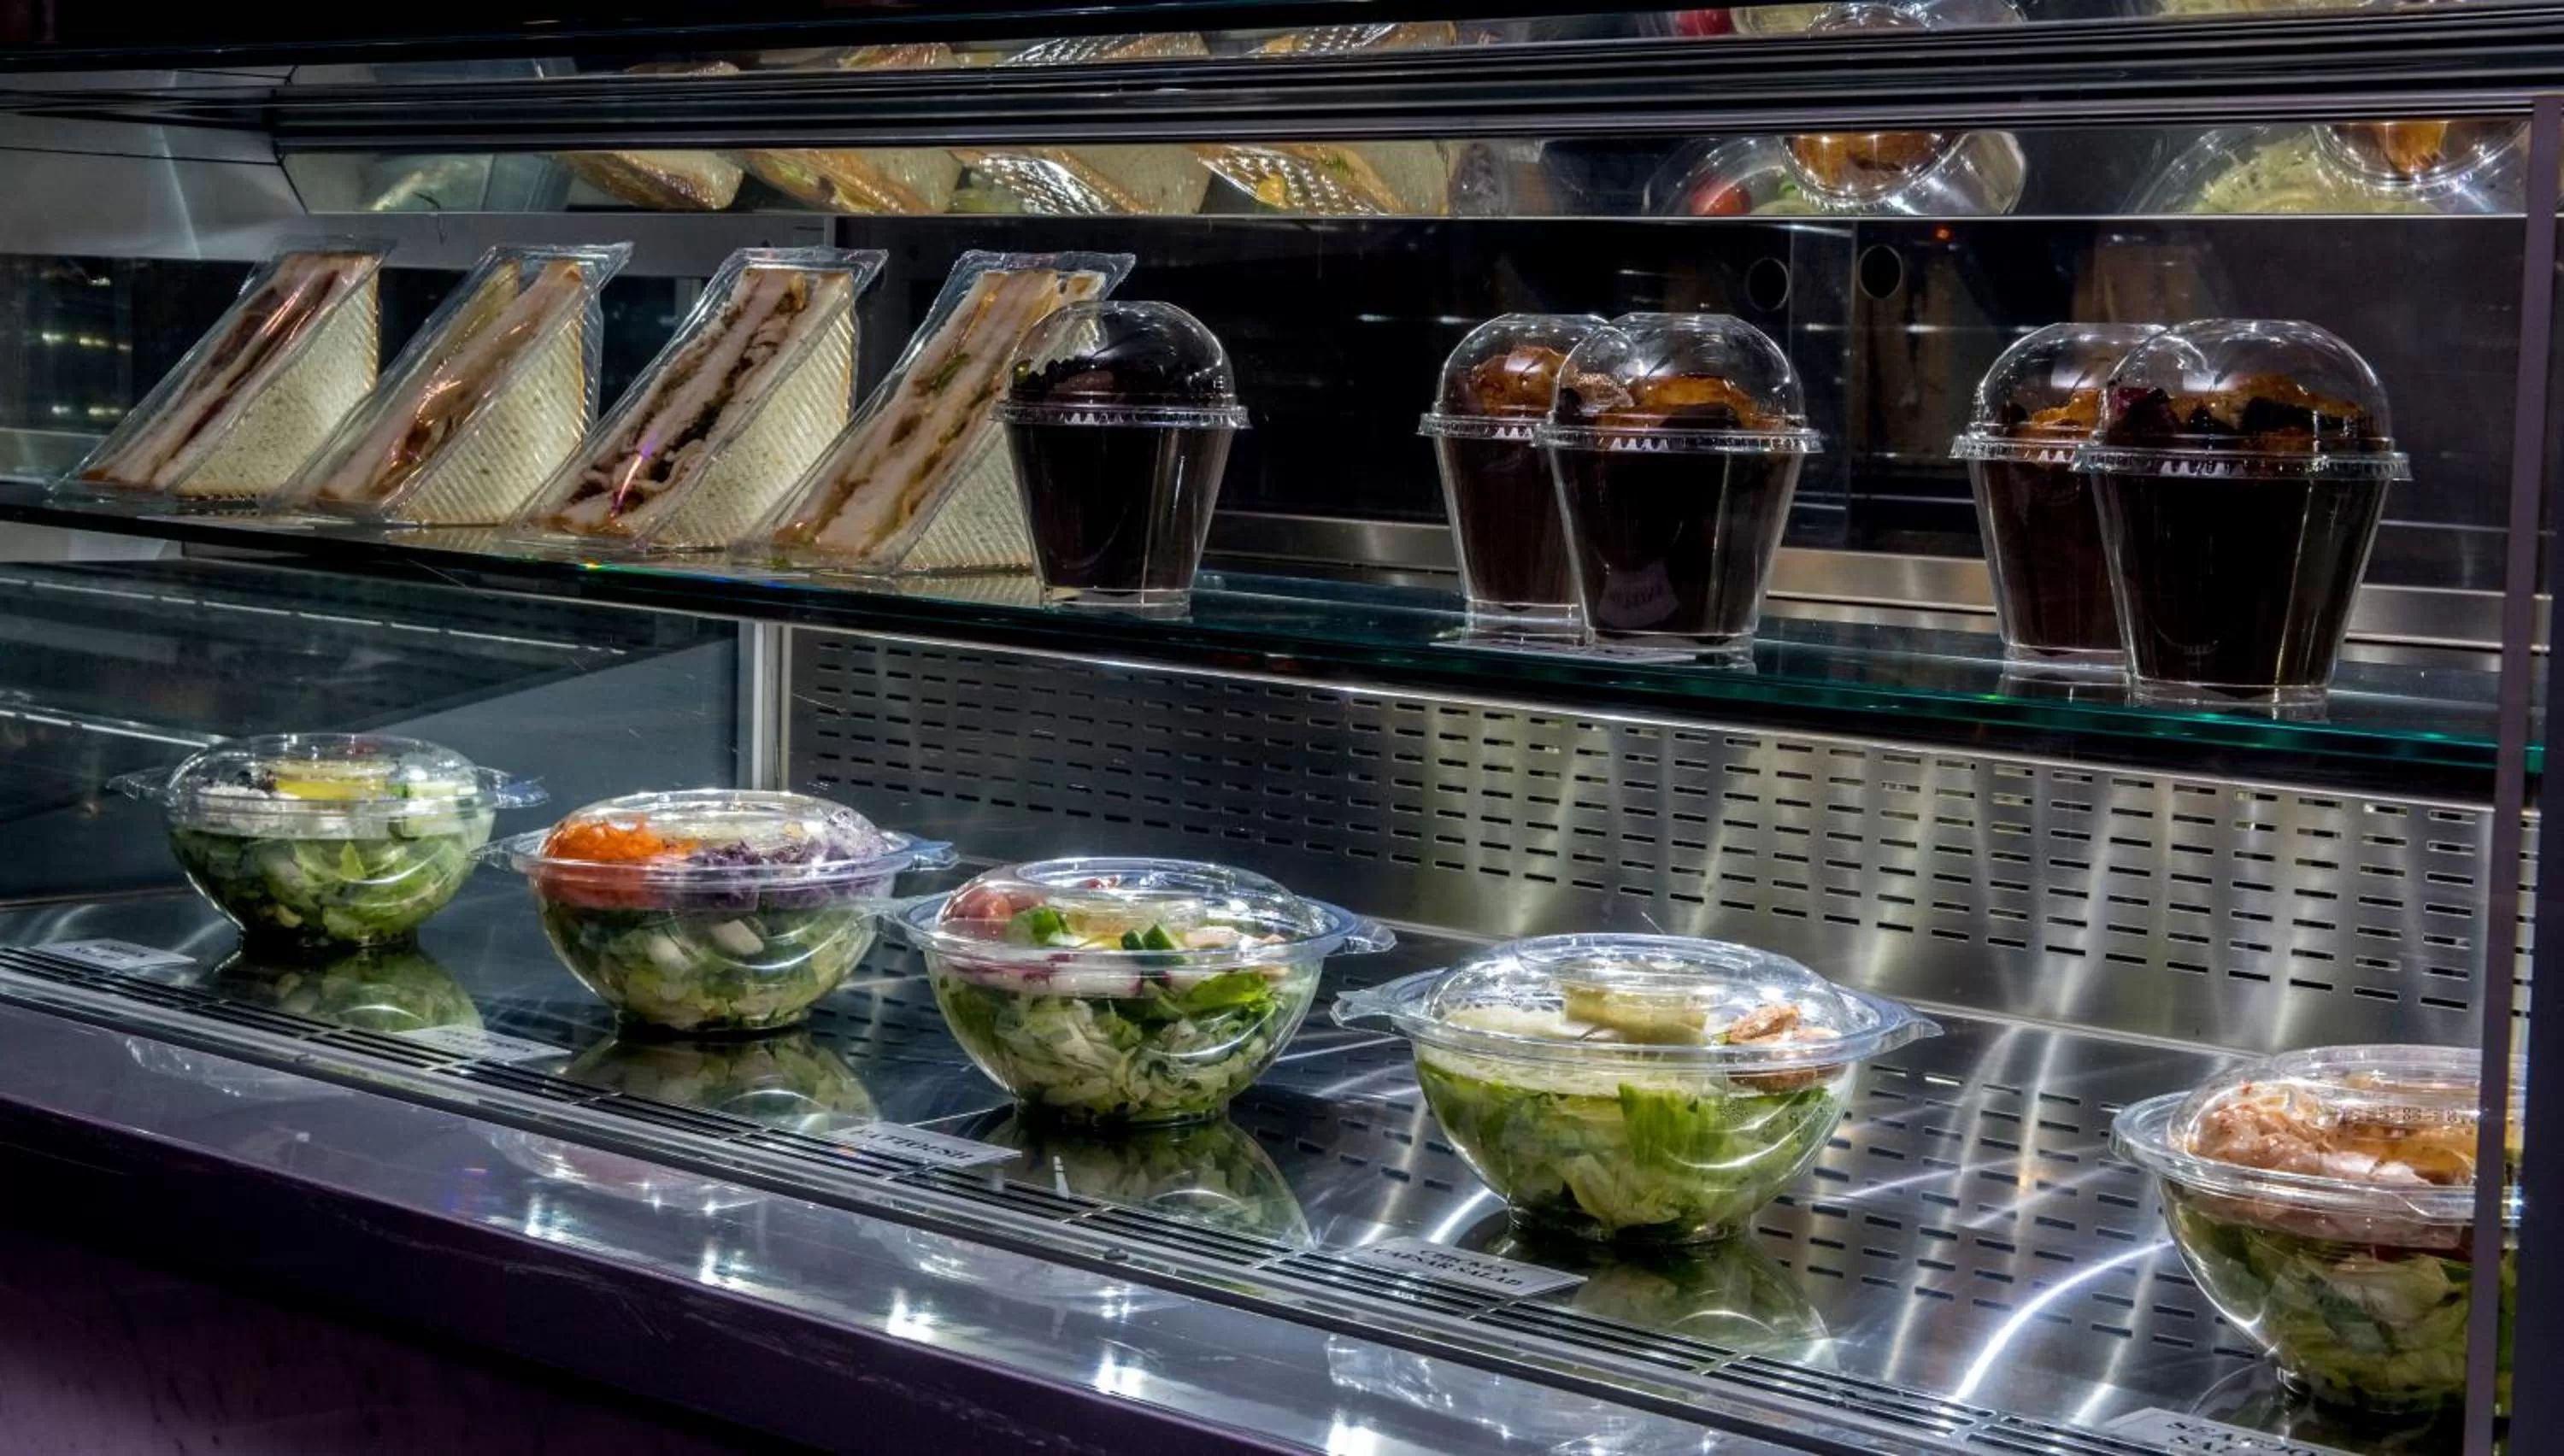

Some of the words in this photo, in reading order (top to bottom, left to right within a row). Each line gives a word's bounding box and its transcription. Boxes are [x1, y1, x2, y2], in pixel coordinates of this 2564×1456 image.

[1373, 1248, 1455, 1269] CAESAR
[1454, 1266, 1523, 1286] SALAD
[1418, 1250, 1515, 1274] CHICKEN
[2165, 1422, 2321, 1456] SEAFOO
